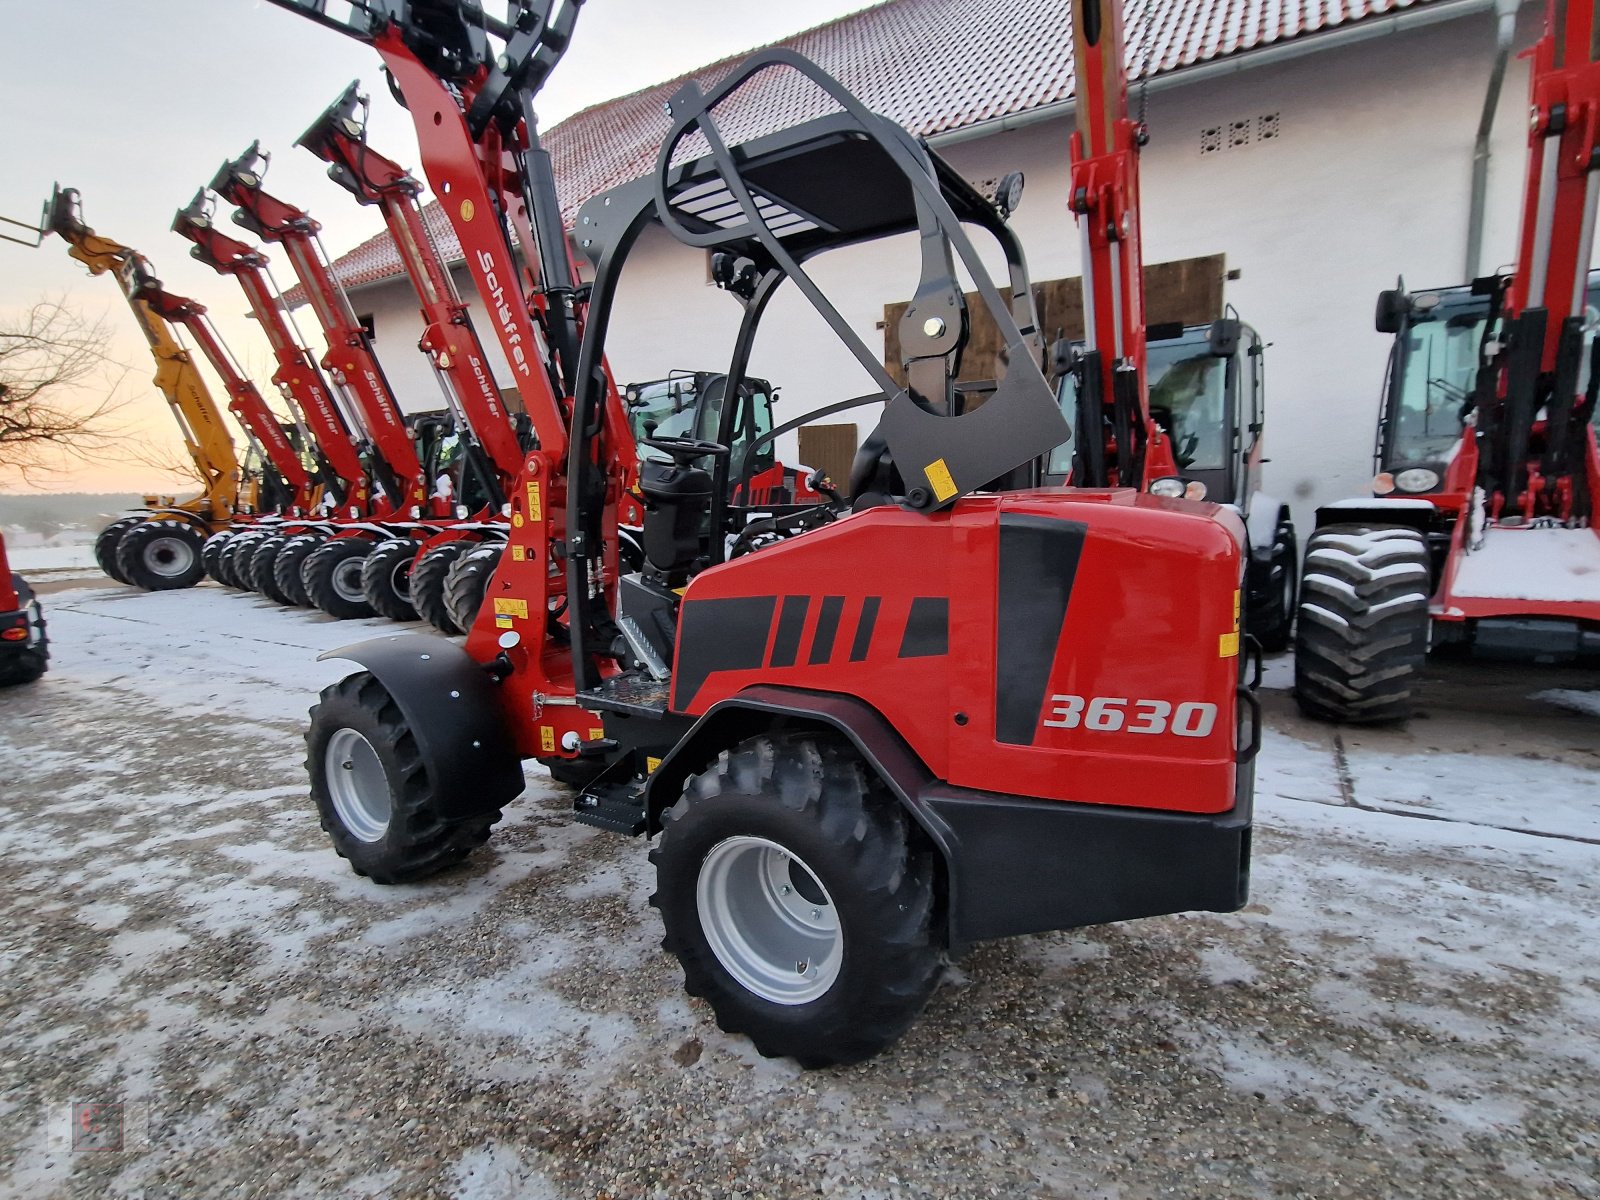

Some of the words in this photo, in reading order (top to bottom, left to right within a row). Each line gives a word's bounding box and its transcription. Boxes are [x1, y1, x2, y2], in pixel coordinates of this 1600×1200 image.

[477, 249, 530, 377] Schäffer
[467, 354, 500, 418] Schäffer
[1043, 694, 1218, 738] 3630
